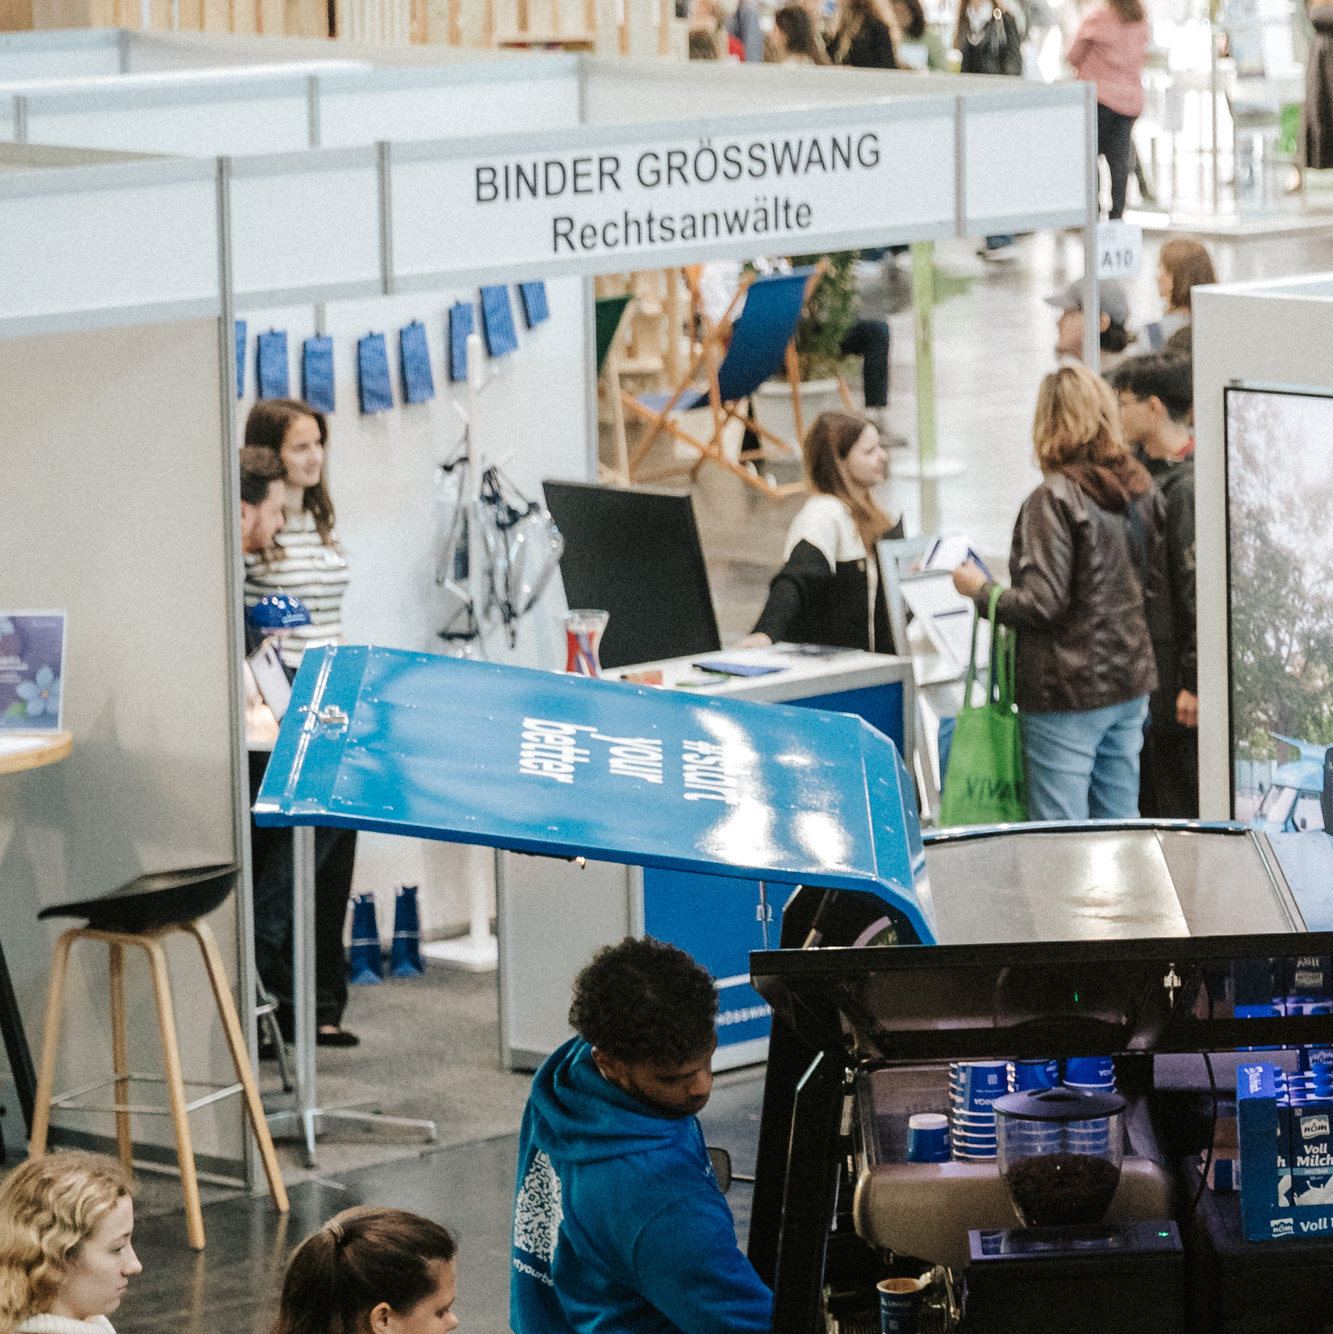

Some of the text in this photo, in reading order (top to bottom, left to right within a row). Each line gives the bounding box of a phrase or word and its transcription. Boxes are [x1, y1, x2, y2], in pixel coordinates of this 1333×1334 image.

[474, 132, 881, 203] BINDER GRÖSSWANG
[553, 197, 814, 254] Rechtsanwälte
[519, 716, 598, 785] better
[590, 731, 664, 785] your
[1303, 1143, 1328, 1155] Voll
[1300, 1217, 1328, 1233] Voll
